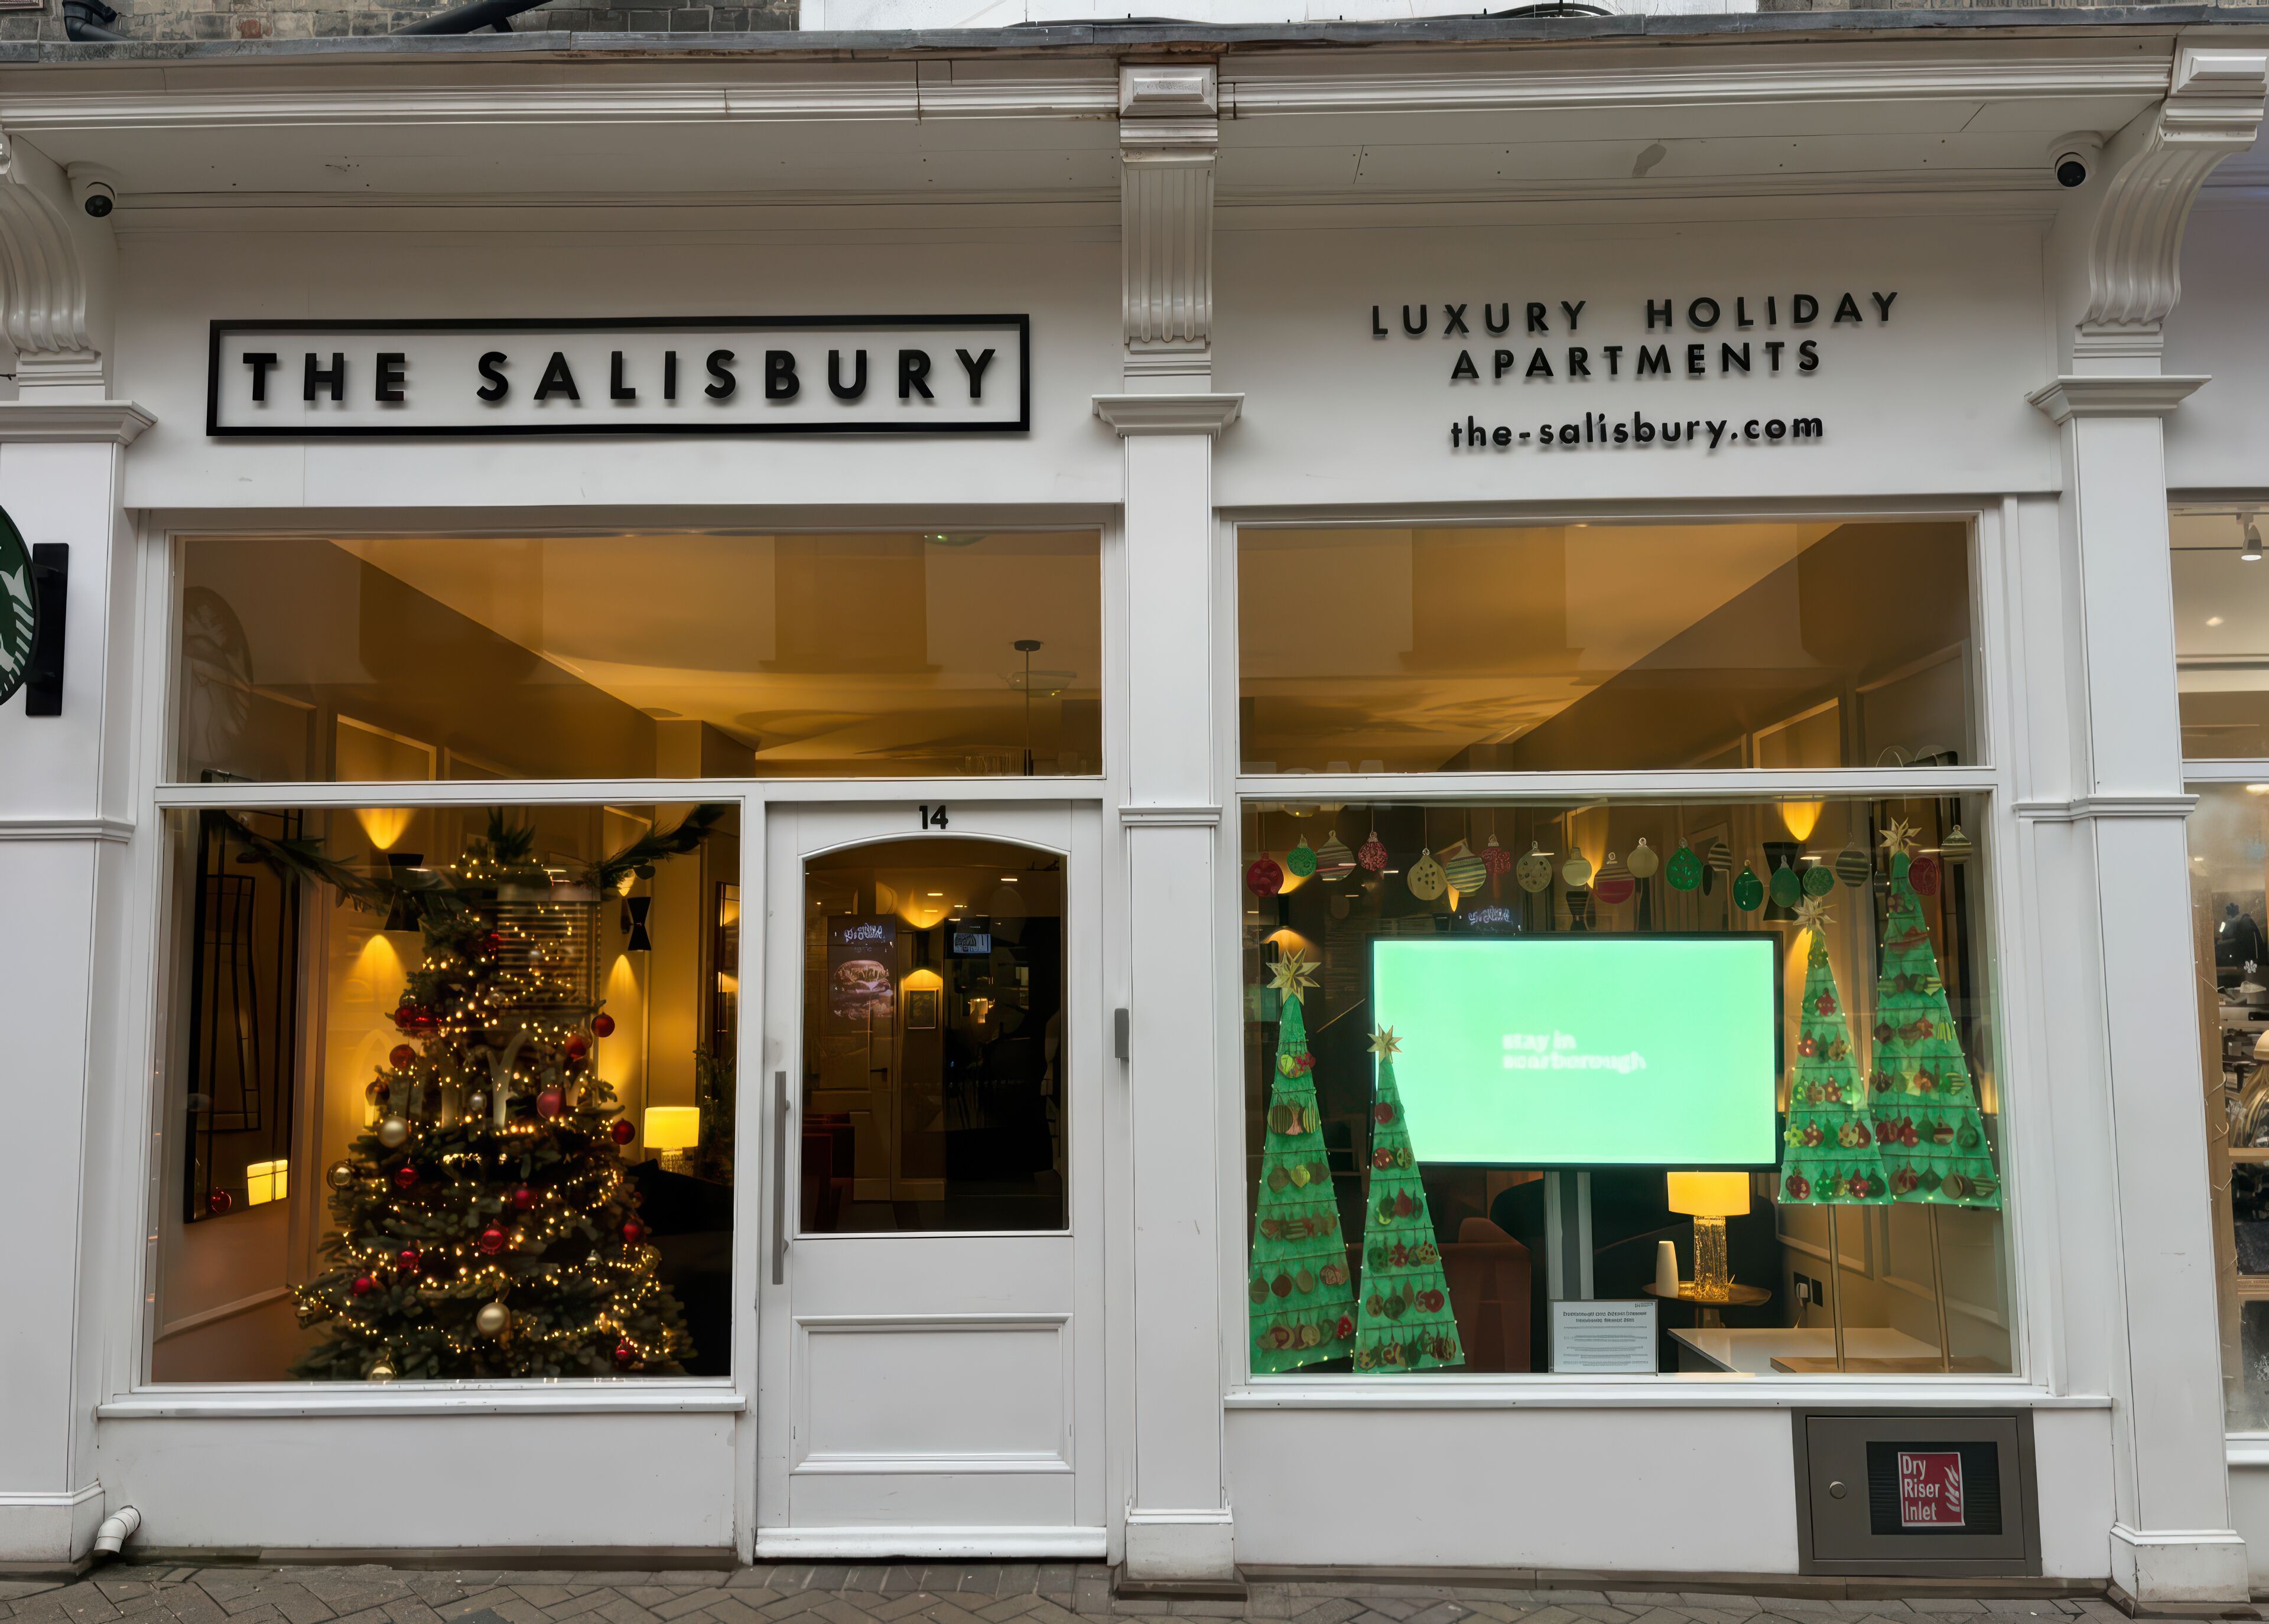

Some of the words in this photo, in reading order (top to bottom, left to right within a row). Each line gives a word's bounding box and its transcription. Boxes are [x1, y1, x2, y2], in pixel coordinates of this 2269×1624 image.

[1372, 300, 1587, 337] LUXURY
[1646, 291, 1898, 329] HOLIDAY
[1451, 340, 1820, 379] APARTMENTS
[242, 352, 405, 402] THE
[476, 349, 996, 401] SALISBURY
[1451, 411, 1823, 449] the-salisbury.com
[918, 805, 949, 830] 14
[1903, 1456, 1926, 1480] Dry
[1904, 1478, 1940, 1498] Riser
[1905, 1501, 1937, 1521] Inlet
